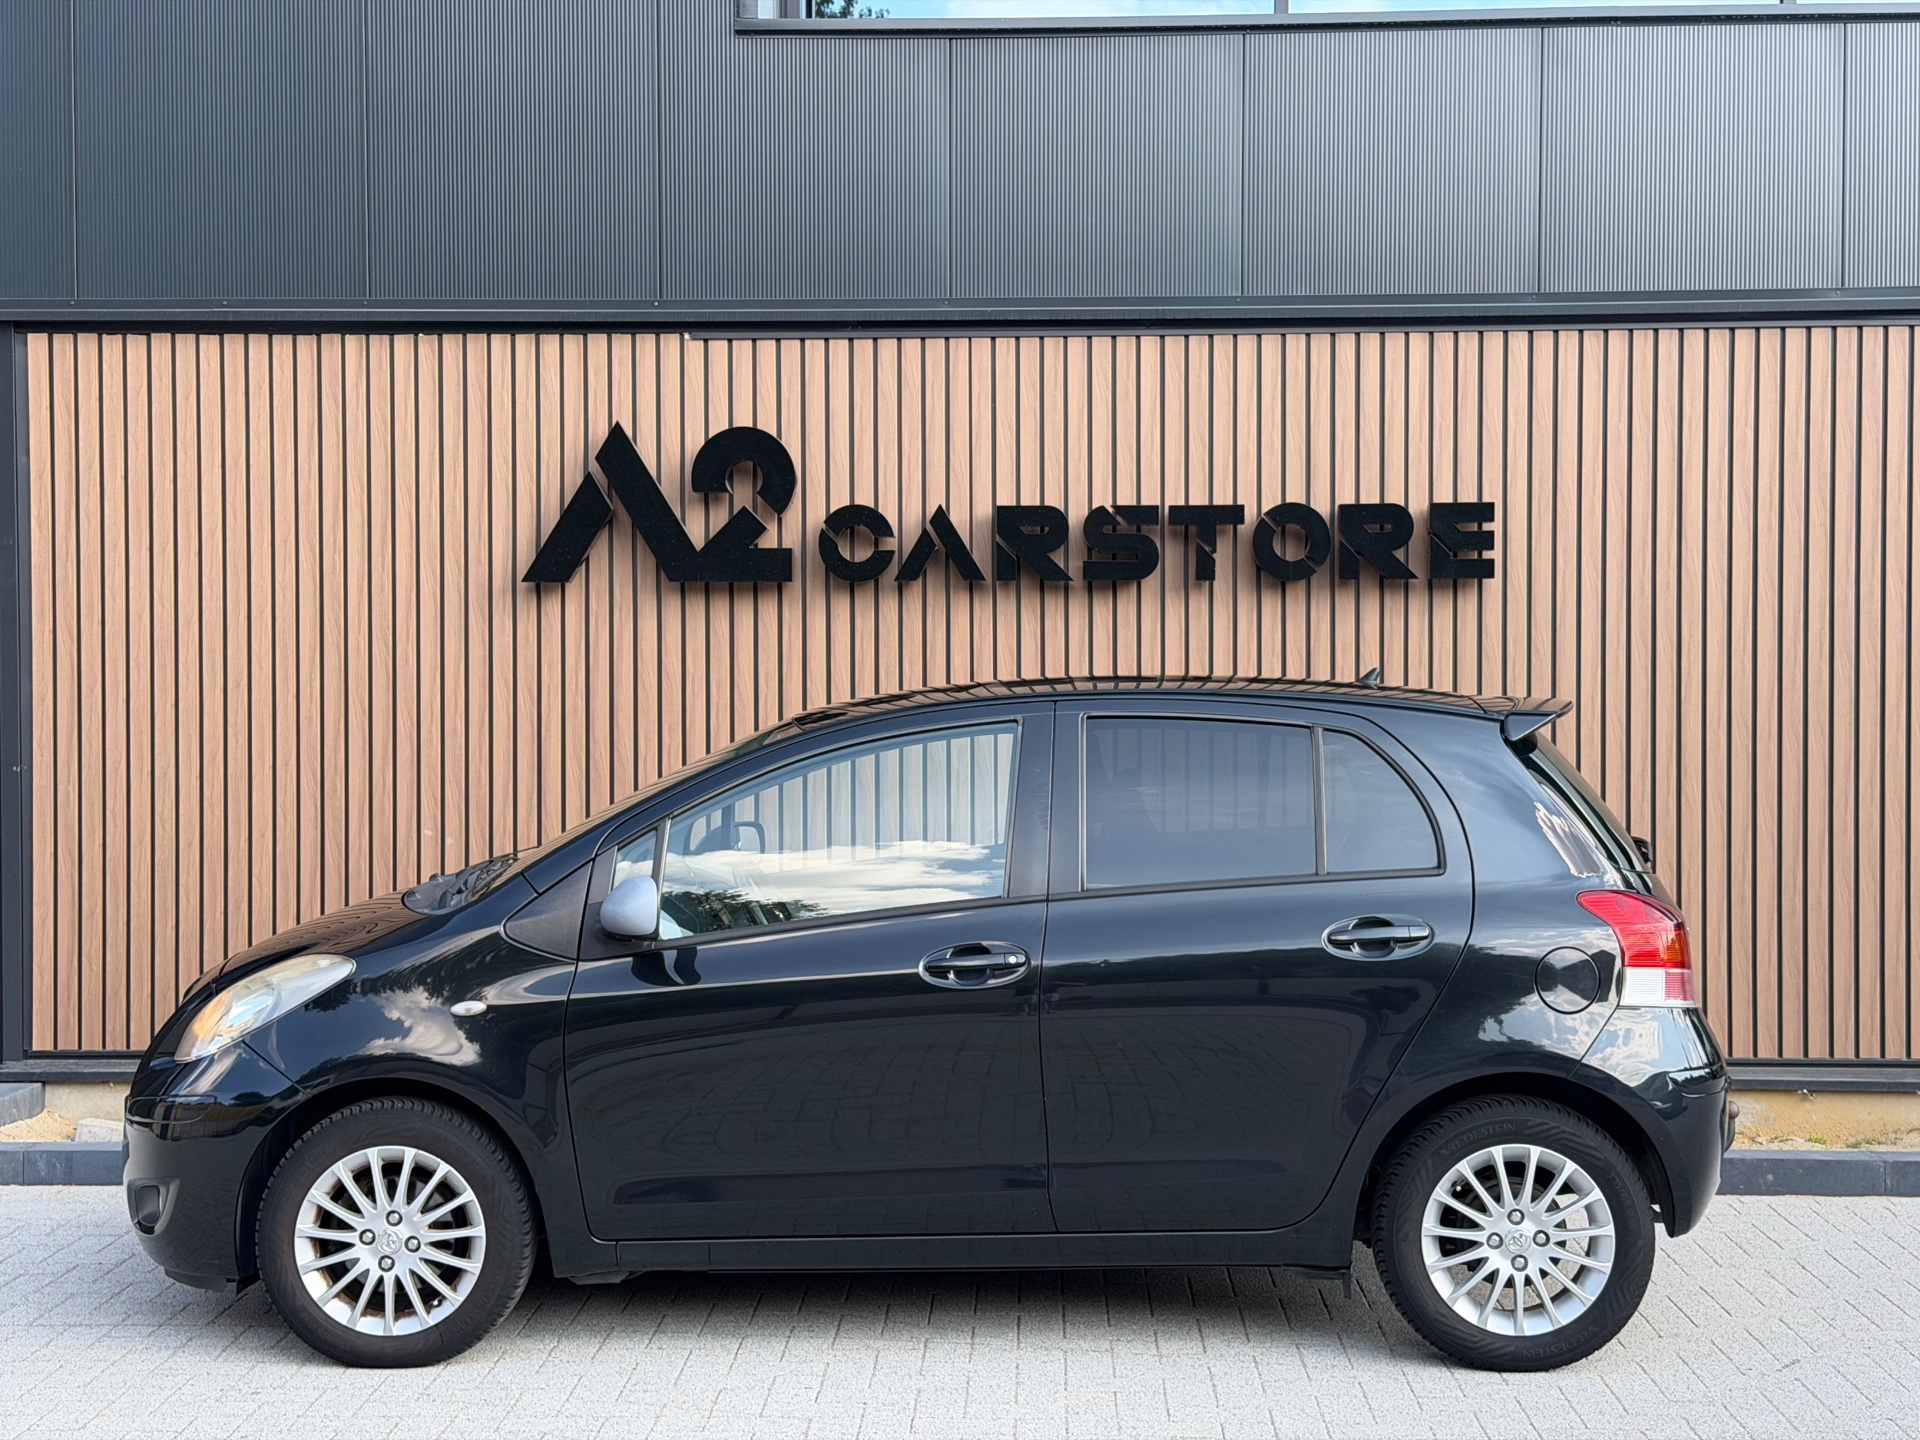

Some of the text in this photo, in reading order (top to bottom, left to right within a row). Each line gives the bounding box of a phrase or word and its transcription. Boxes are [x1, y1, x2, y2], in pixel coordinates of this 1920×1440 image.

[521, 420, 1494, 583] A2 CARSTORE
[1440, 1122, 1516, 1156] VREDESTEIN
